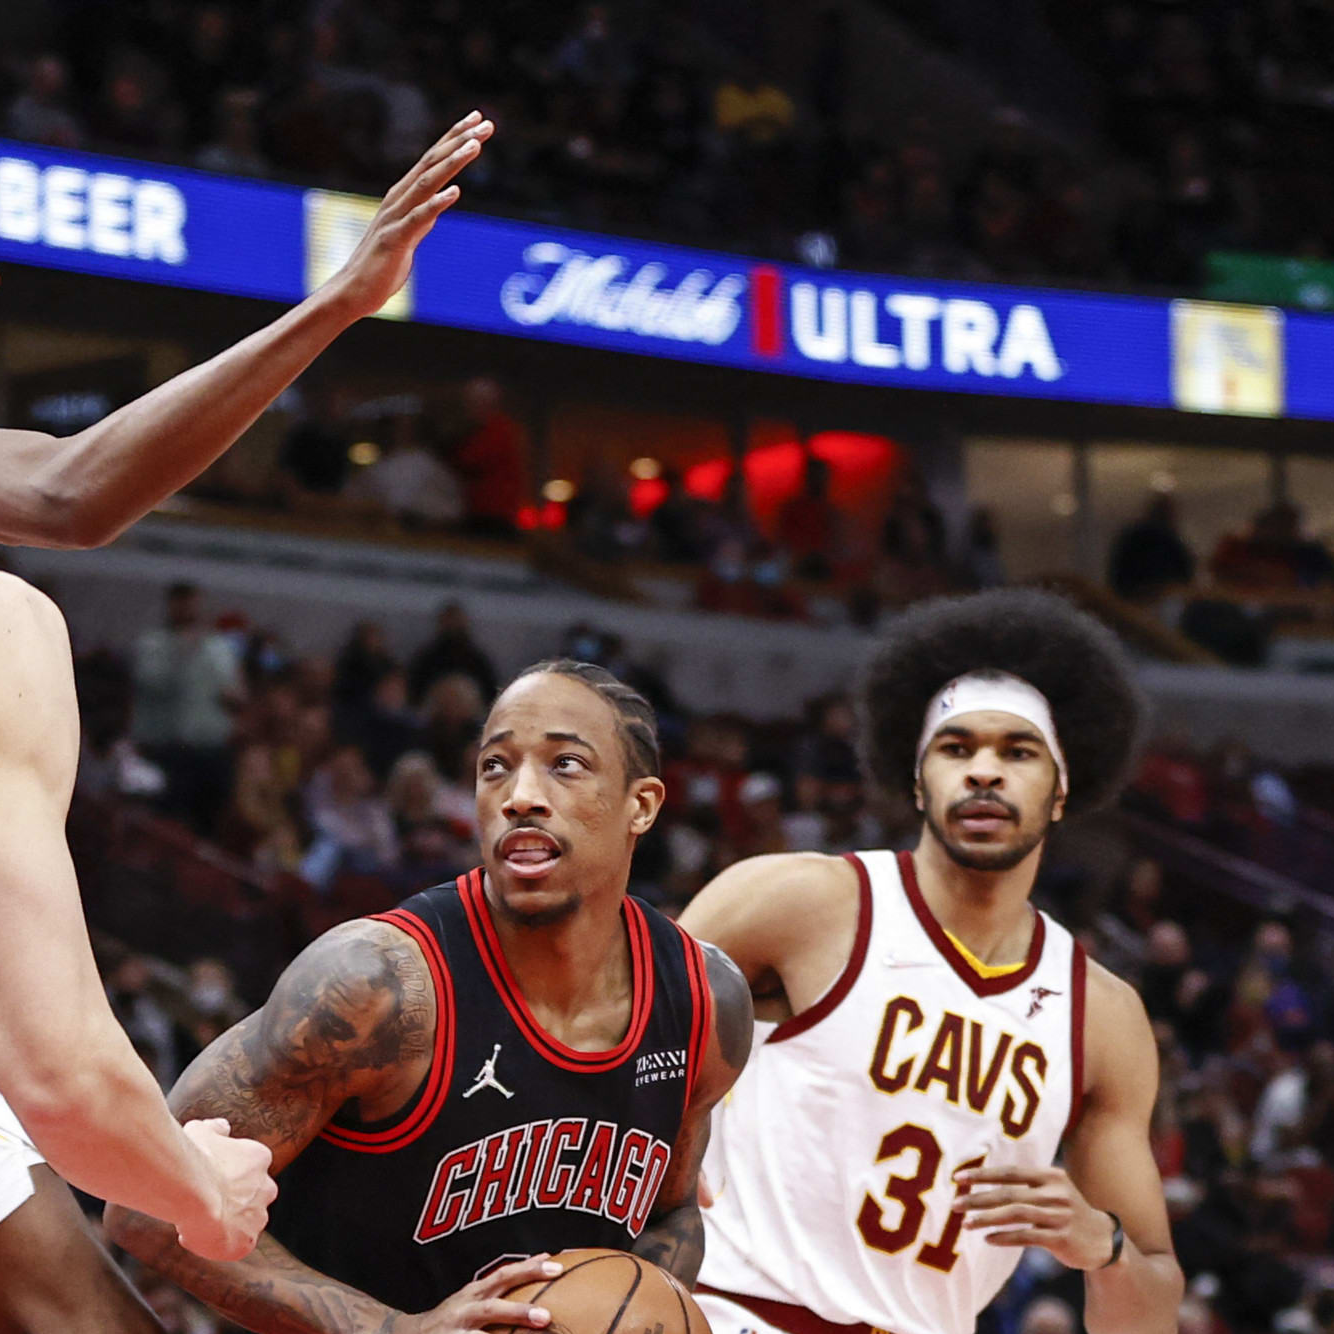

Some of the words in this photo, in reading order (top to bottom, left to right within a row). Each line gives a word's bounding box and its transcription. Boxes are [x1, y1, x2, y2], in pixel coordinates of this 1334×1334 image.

[790, 281, 1063, 382] ULTRA
[635, 1068, 685, 1087] EYEWEAR
[870, 995, 1048, 1139] CAVS
[413, 1118, 671, 1245] CHICAGO
[856, 1122, 989, 1273] 31
